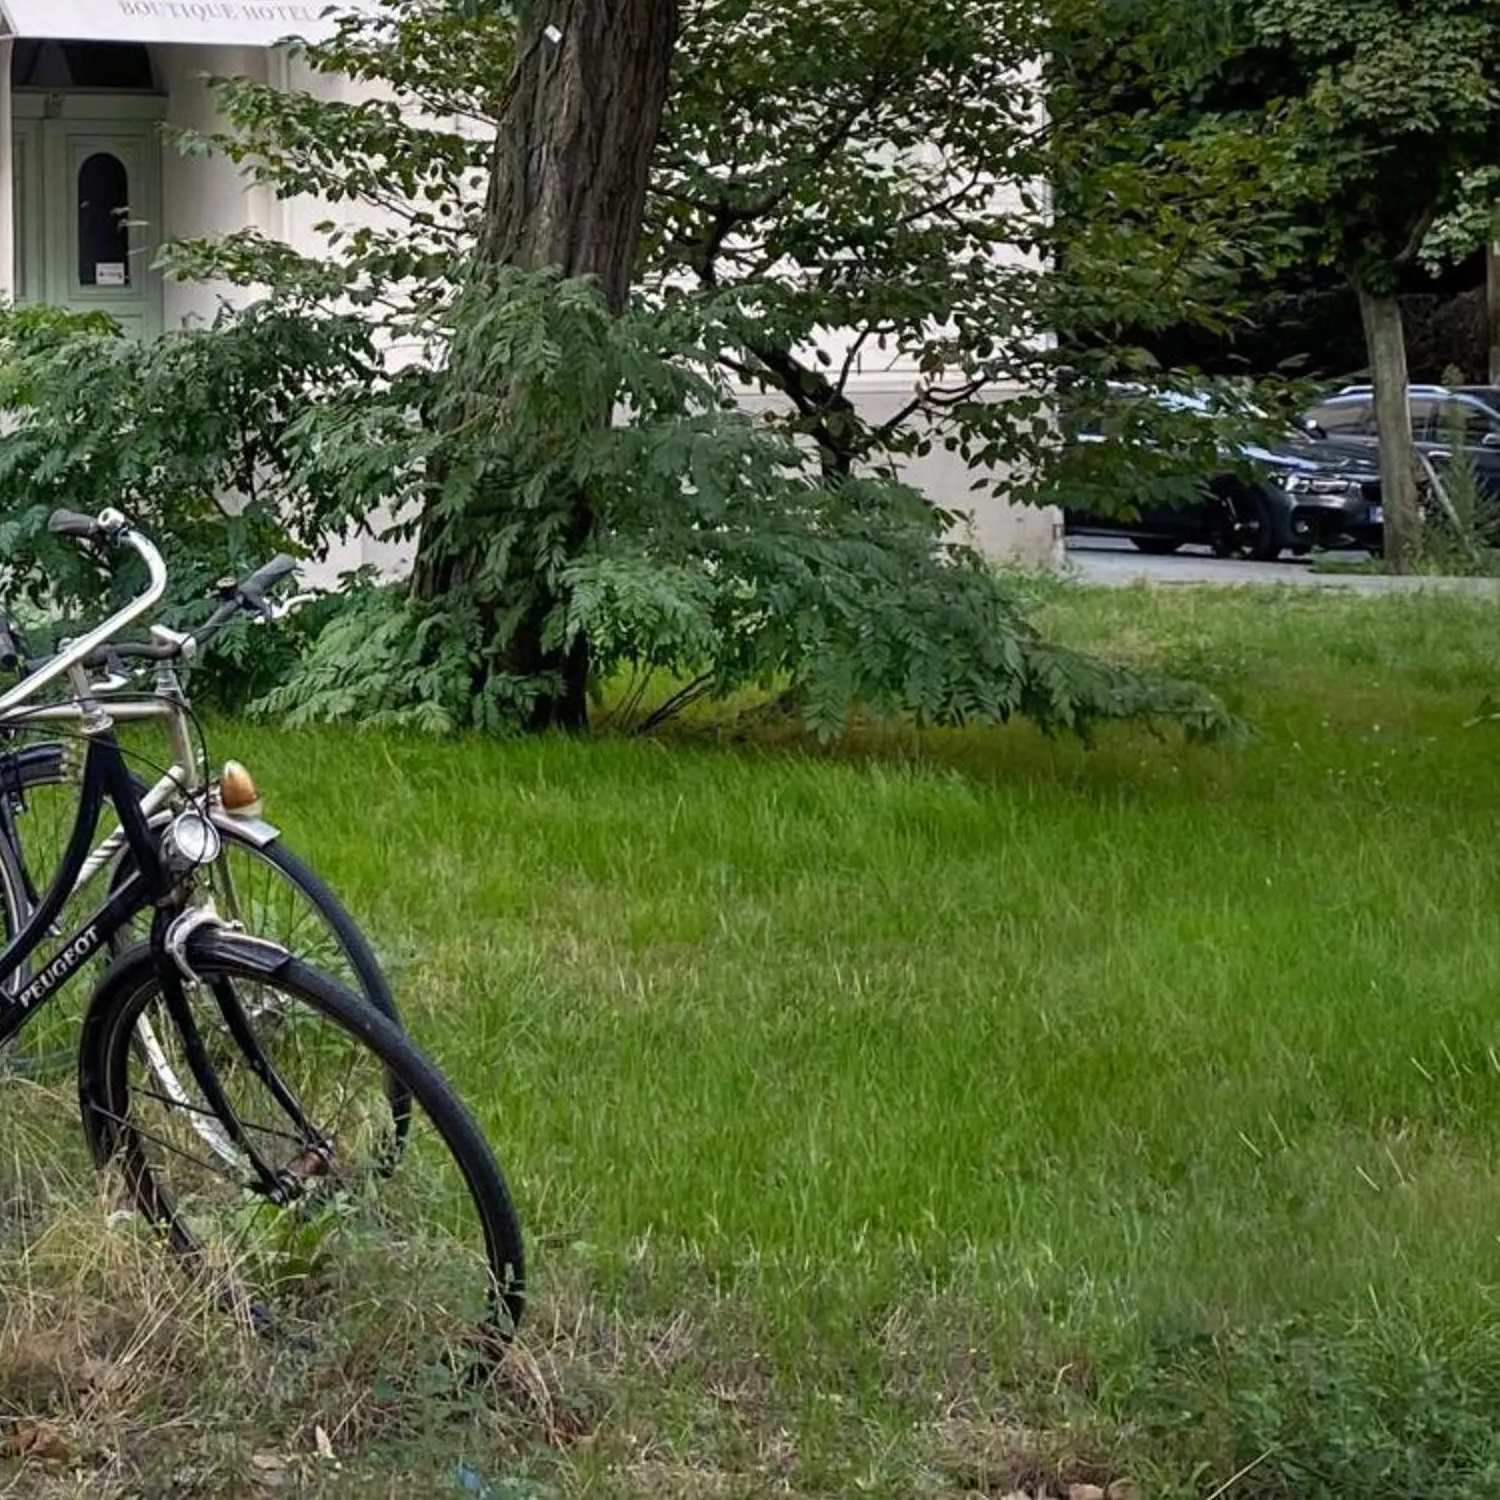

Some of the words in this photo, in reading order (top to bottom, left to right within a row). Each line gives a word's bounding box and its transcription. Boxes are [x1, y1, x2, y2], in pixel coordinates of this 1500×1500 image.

[118, 0, 238, 22] BOUTIQUE
[241, 4, 319, 22] HOTEL
[19, 925, 99, 1008] PEUGEOT
